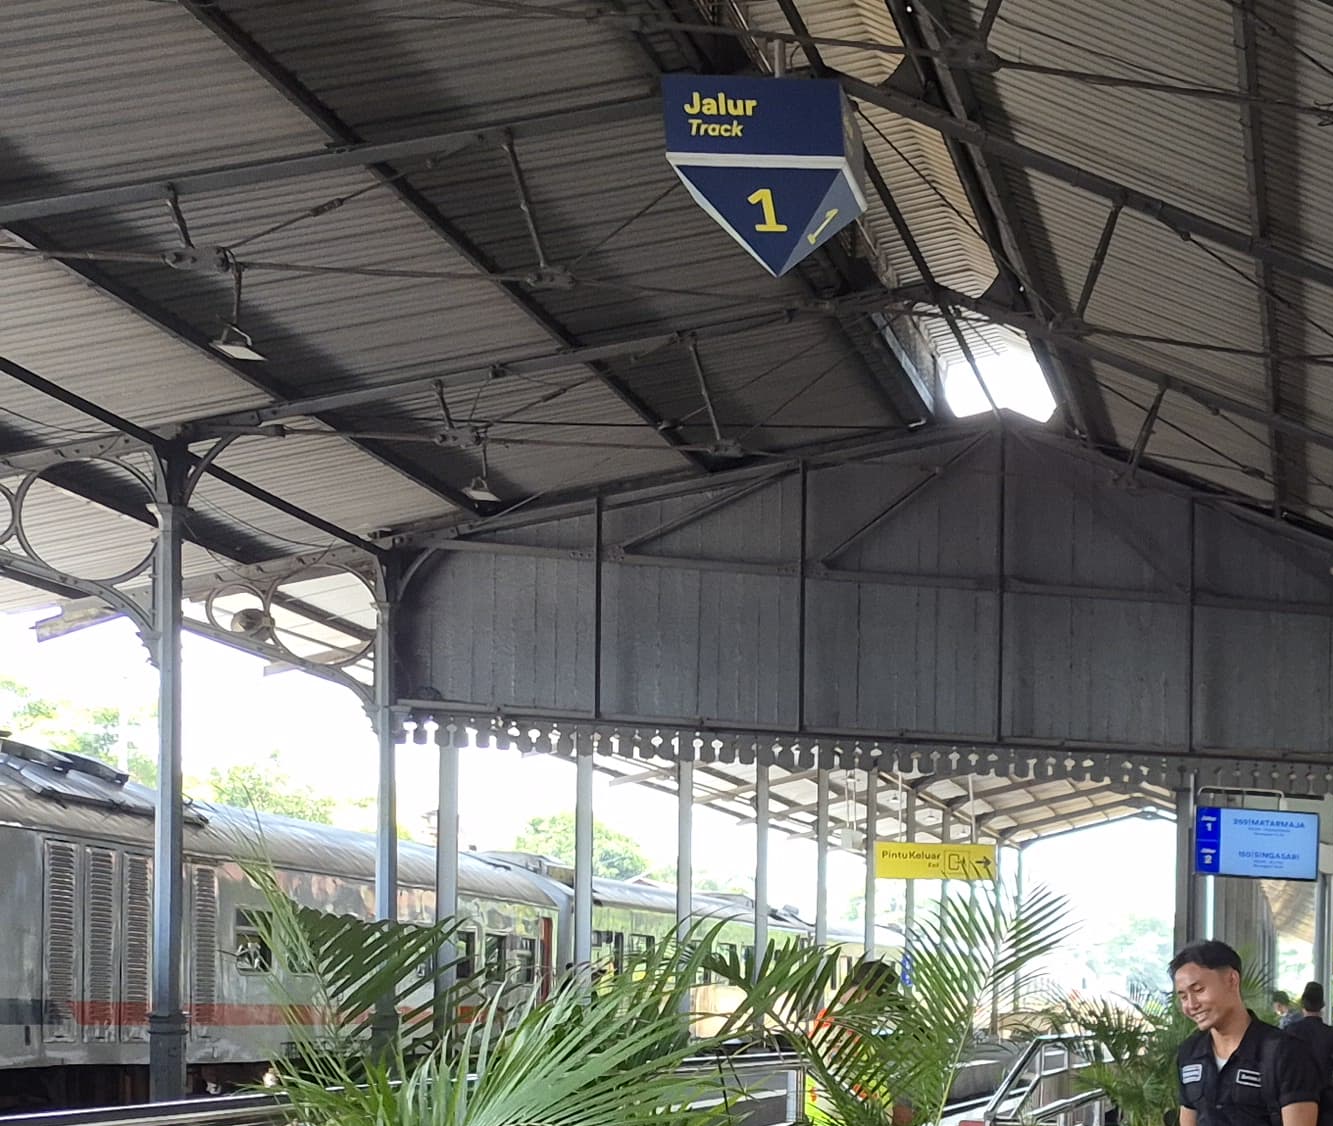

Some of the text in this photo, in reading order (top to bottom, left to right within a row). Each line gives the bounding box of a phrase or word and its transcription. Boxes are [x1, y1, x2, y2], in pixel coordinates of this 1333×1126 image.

[683, 91, 758, 117] Jalur
[687, 118, 744, 137] Track
[746, 187, 789, 233] 1
[881, 850, 941, 860] Pintu Keluar
